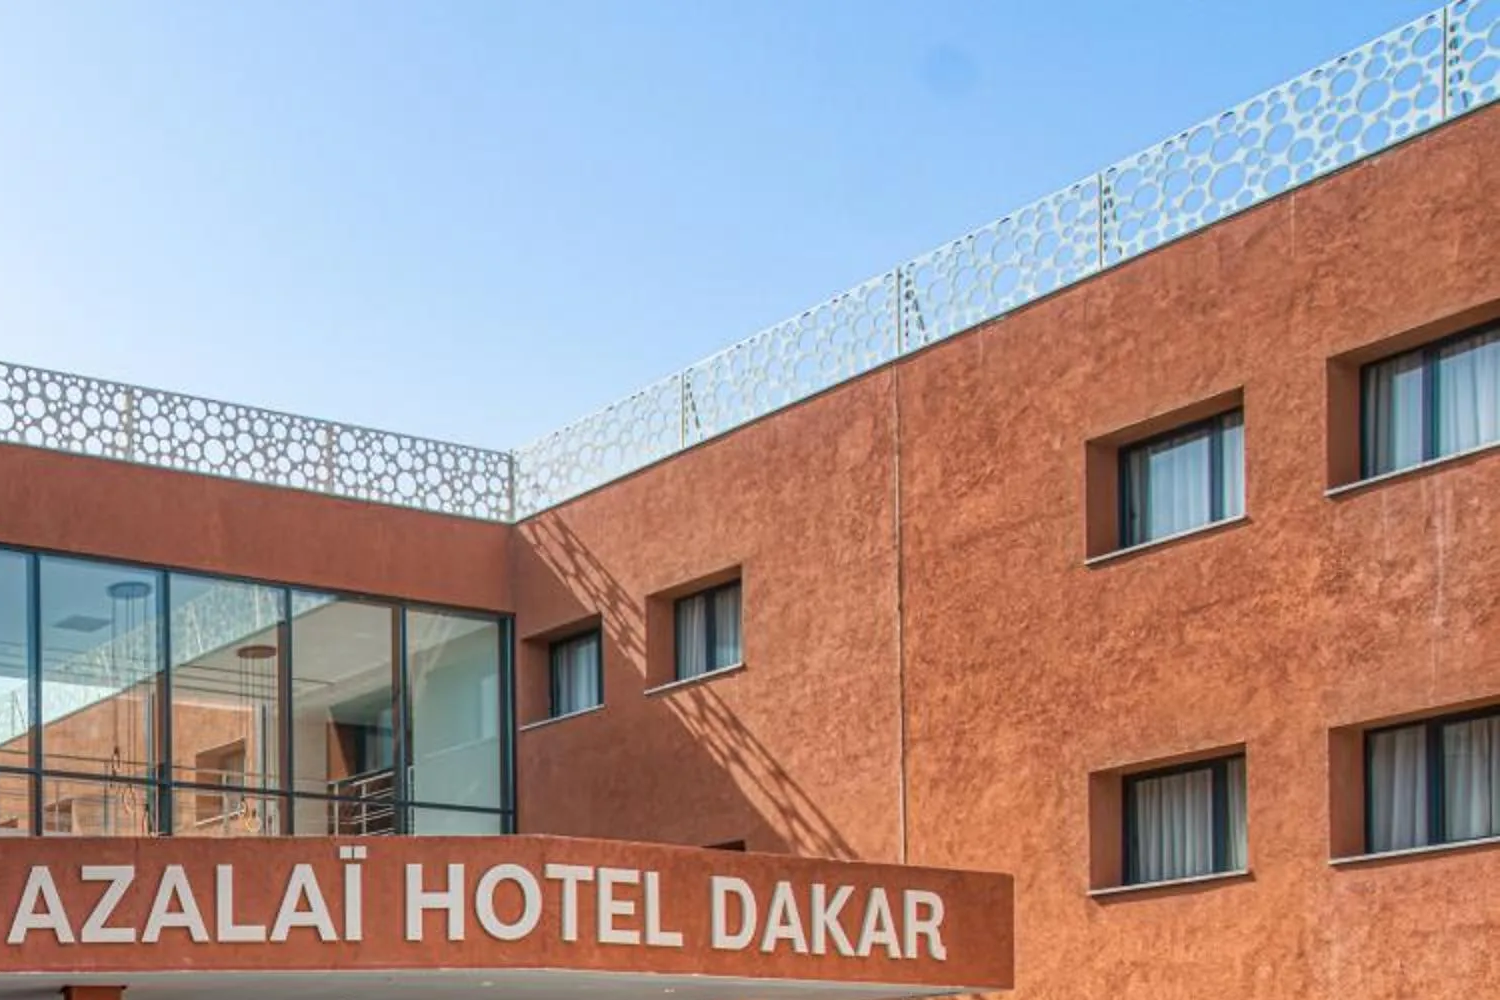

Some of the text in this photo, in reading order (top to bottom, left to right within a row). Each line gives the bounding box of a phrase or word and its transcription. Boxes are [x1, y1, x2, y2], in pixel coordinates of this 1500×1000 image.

[7, 845, 948, 962] AZALAÏ HOTEL DAKAR
